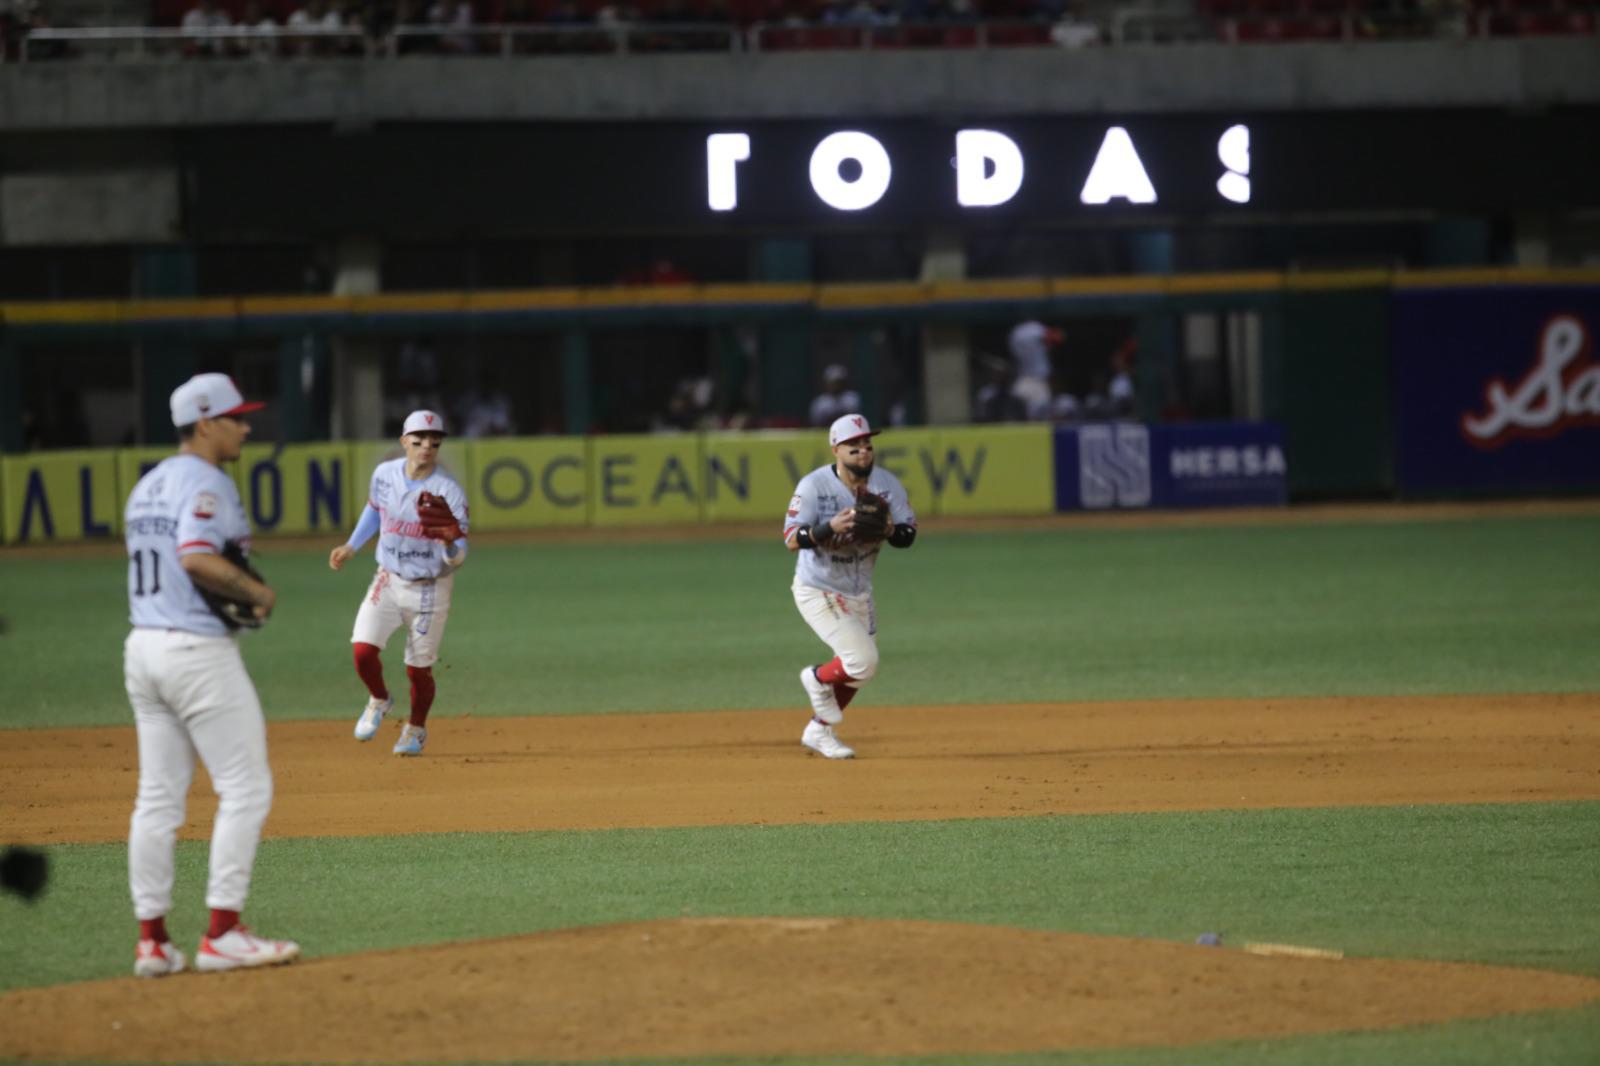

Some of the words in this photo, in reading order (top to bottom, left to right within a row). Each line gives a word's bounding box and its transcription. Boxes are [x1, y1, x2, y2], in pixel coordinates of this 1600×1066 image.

[481, 453, 750, 510] OCEAN
[780, 443, 989, 500] VEW
[1170, 445, 1287, 478] HERSA
[132, 548, 161, 597] 11
